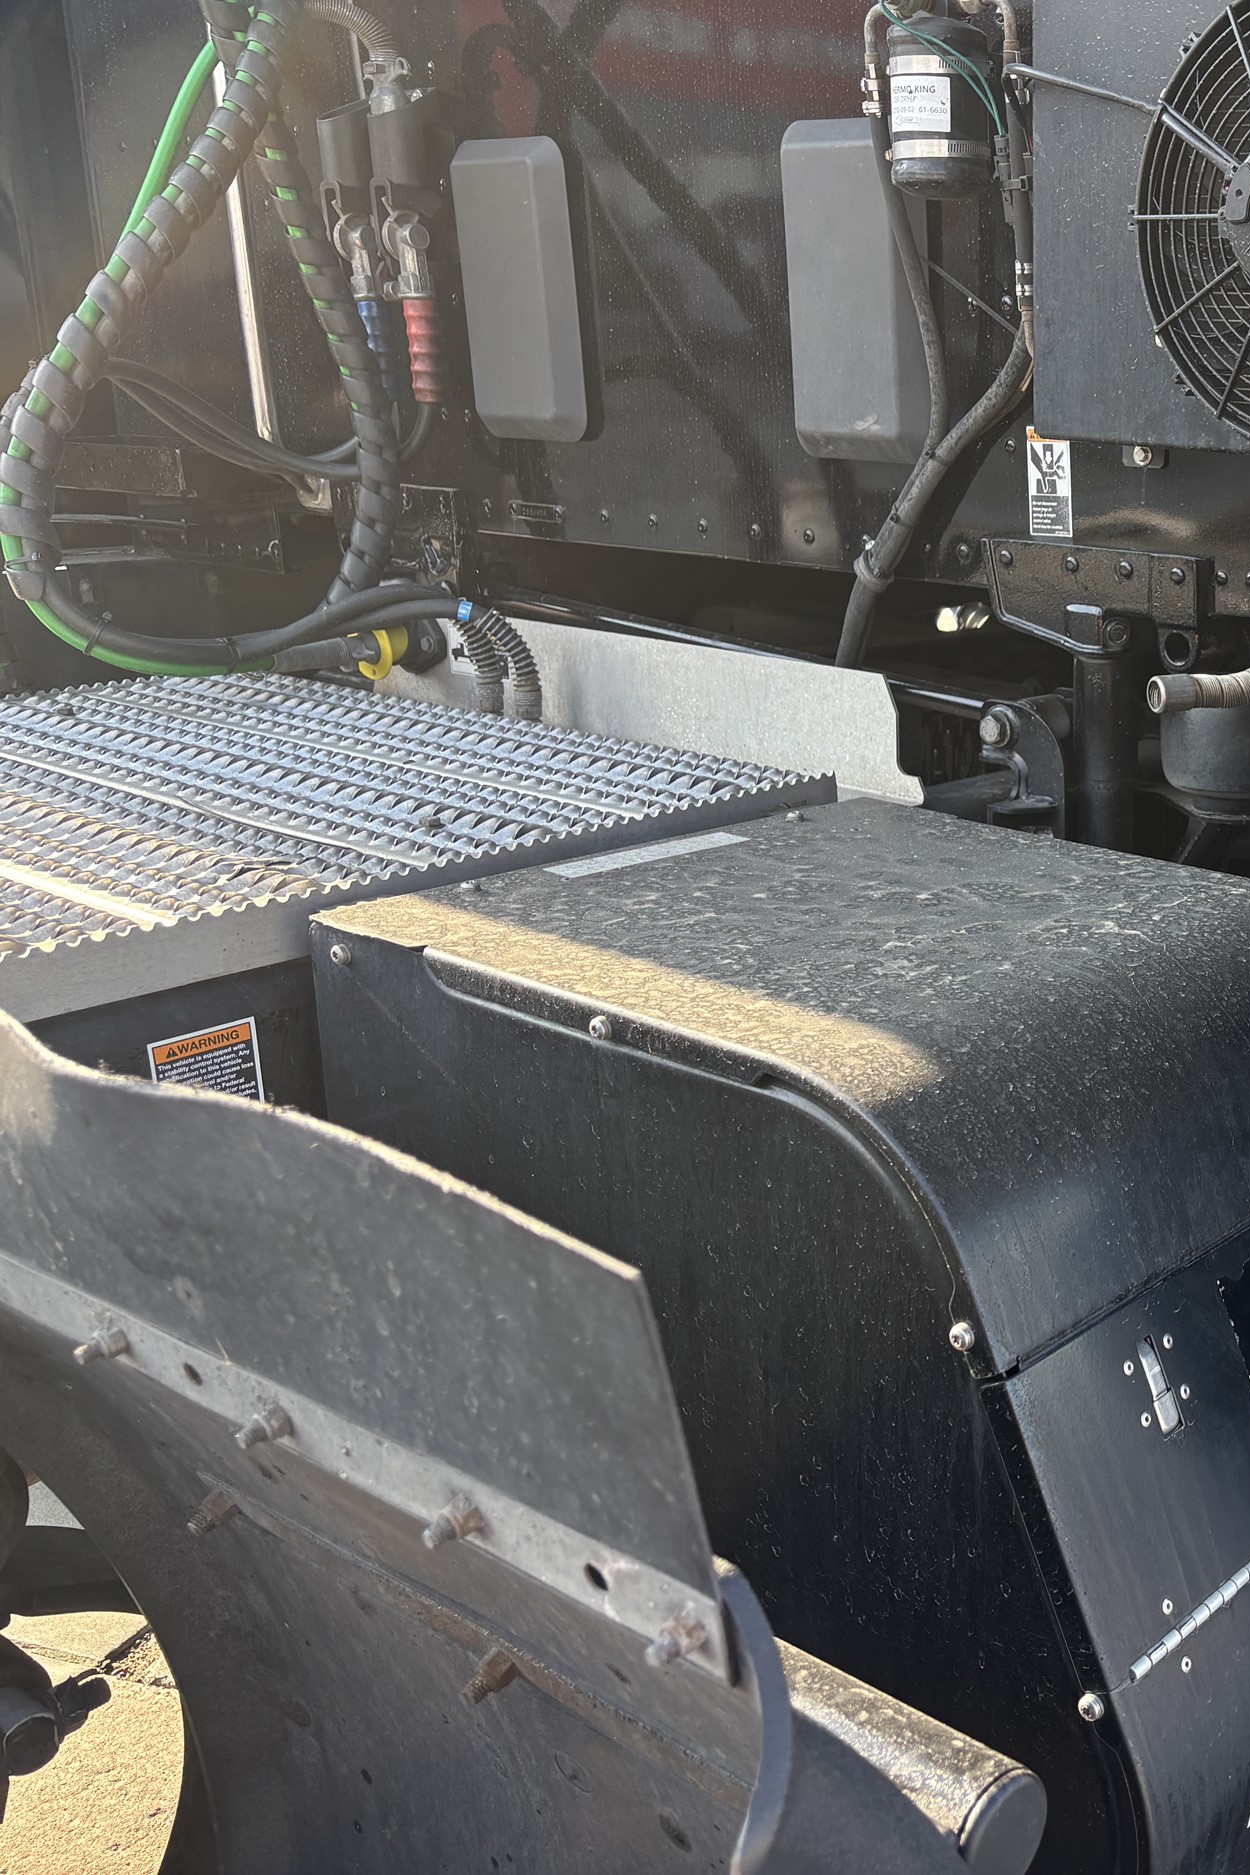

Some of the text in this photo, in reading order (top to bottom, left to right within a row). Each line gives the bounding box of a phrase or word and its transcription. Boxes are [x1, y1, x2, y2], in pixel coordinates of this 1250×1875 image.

[915, 85, 936, 93] KING
[177, 1030, 240, 1054] WARNING
[173, 1057, 195, 1068] vehicle
[203, 1046, 232, 1060] equipped
[233, 1043, 246, 1051] with
[165, 1067, 189, 1077] stability
[190, 1060, 213, 1070] control
[213, 1054, 238, 1065] system.
[239, 1049, 250, 1057] Any
[221, 1058, 242, 1068] vehicle
[203, 1070, 221, 1080] could
[222, 1066, 240, 1075] cause
[216, 1074, 236, 1084] and/or
[222, 1077, 245, 1088] Federal
[239, 1081, 256, 1090] result
